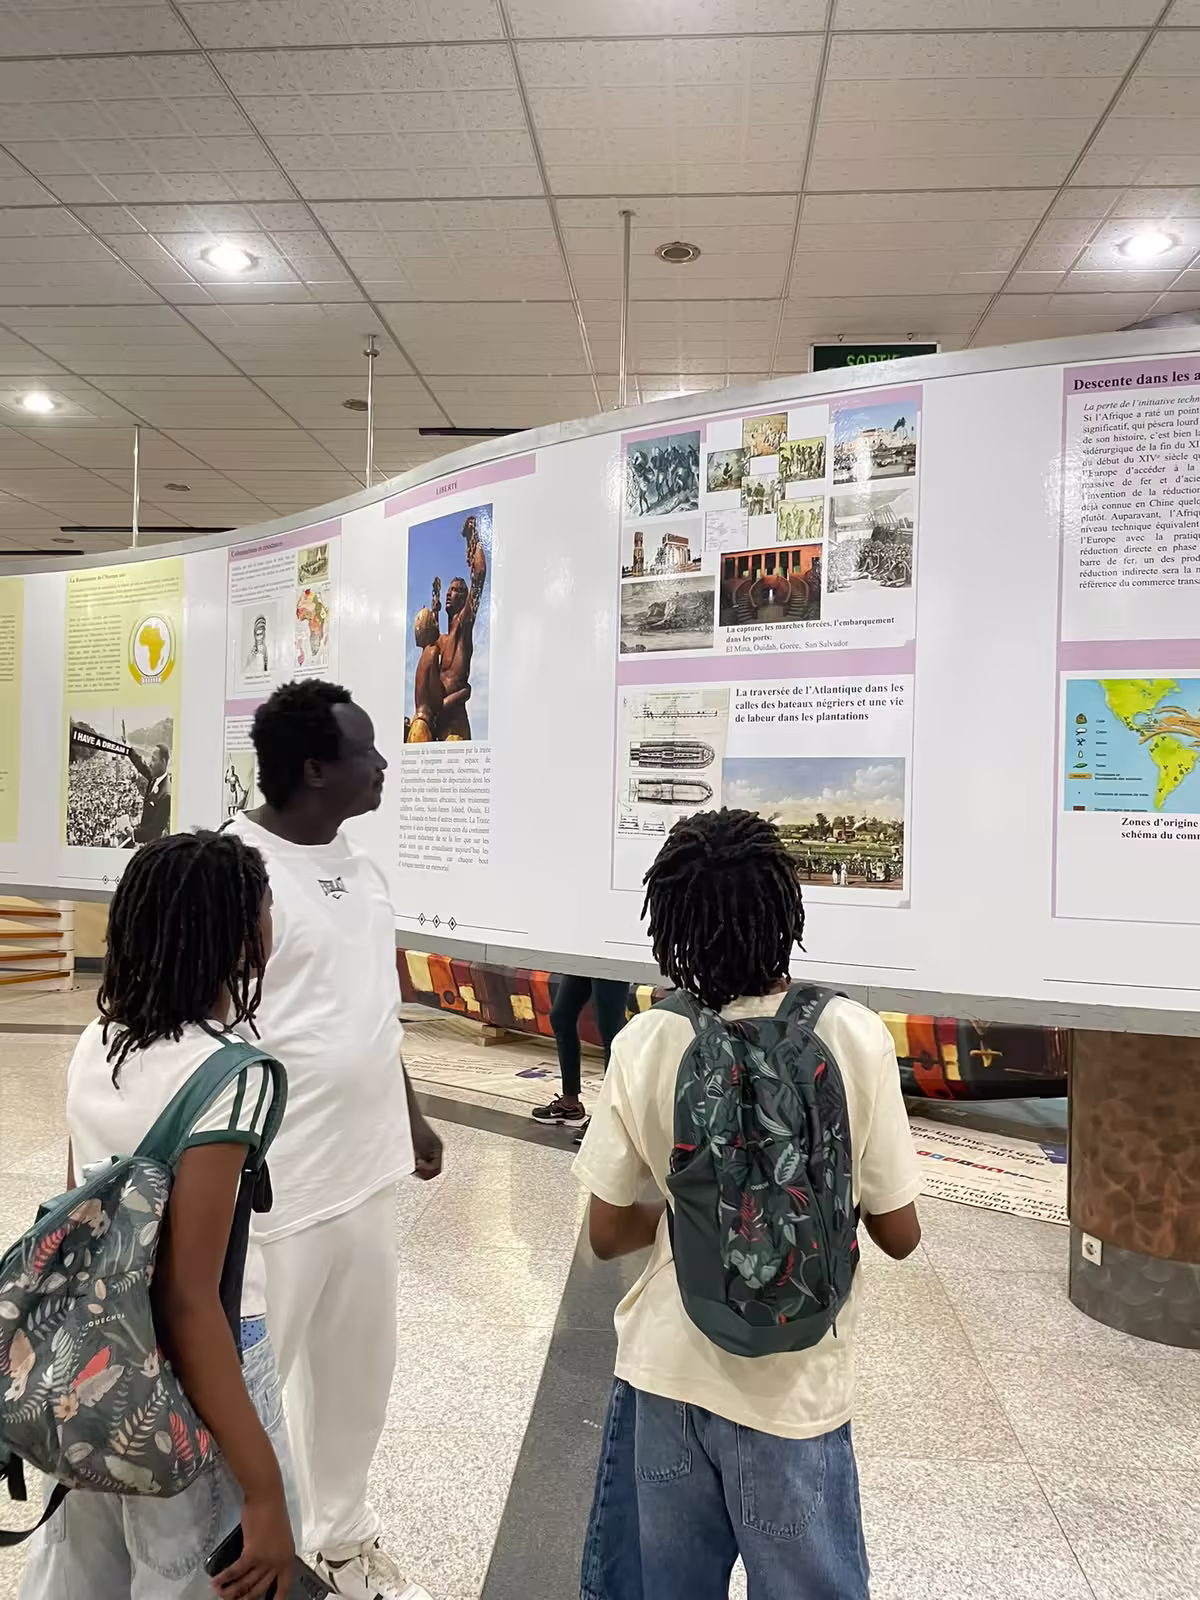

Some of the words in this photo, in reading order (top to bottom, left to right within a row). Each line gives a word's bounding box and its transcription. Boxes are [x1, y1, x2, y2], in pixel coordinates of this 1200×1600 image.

[1074, 376, 1132, 391] Descente
[1137, 374, 1168, 385] dans
[1173, 371, 1190, 382] les
[1096, 402, 1118, 412] perte
[1120, 400, 1130, 408] de
[1132, 398, 1175, 407] l'initiative
[1178, 395, 1200, 404] techn
[1084, 414, 1092, 422] Si
[1096, 412, 1133, 421] l'Afrique
[1145, 410, 1160, 418] raté
[1178, 407, 1199, 419] point
[1083, 423, 1129, 434] significatif,
[1132, 422, 1145, 431] qui
[1177, 418, 1199, 426] lourd
[1083, 436, 1092, 444] de
[1114, 434, 1147, 443] histoire,
[1150, 431, 1170, 439] c'est
[1173, 429, 1191, 438] bien
[1083, 446, 1133, 456] sidérurgique
[1160, 442, 1171, 450] fin
[1175, 441, 1185, 449] du
[1097, 457, 1119, 465] début
[1124, 456, 1134, 464] du
[1165, 452, 1188, 461] siècle
[1083, 468, 1118, 477] l'Europe
[1126, 466, 1166, 475] d'accéder
[1174, 464, 1179, 472] à
[1082, 491, 1126, 500] l'invention
[1133, 489, 1142, 497] de
[1150, 499, 1174, 507] Chine
[1111, 512, 1161, 521] Auparavant,
[1081, 524, 1108, 533] niveau
[1112, 523, 1151, 534] technique
[1156, 521, 1199, 530] équivalent
[1080, 536, 1116, 545] l'Europe
[1156, 533, 1163, 541] la
[1080, 546, 1118, 555] réduction
[1124, 545, 1152, 553] directe
[1173, 544, 1197, 553] phase
[1080, 559, 1101, 567] barre
[1182, 555, 1200, 564] prod
[1080, 569, 1117, 577] réduction
[1122, 567, 1158, 576] indirecte
[1184, 566, 1191, 574] la
[1080, 580, 1117, 589] référence
[737, 625, 764, 634] capture,
[834, 617, 895, 627] l'embarquement
[743, 634, 751, 642] les
[753, 635, 772, 644] ports:
[819, 640, 848, 648] Salvador
[736, 689, 747, 697] La
[750, 687, 790, 696] traversée
[806, 684, 862, 696] l'Atlantique
[865, 684, 888, 692] dans
[891, 683, 904, 691] les
[735, 701, 758, 710] calles
[761, 701, 775, 709] des
[778, 699, 813, 708] bateaux
[816, 698, 854, 709] négriers
[869, 698, 887, 706] une
[735, 714, 745, 722] de
[747, 713, 776, 722] labeur
[778, 713, 799, 722] dans
[802, 712, 813, 721] les
[816, 712, 869, 723] plantations
[73, 731, 77, 740] I
[78, 733, 95, 745] HAVE
[102, 740, 125, 753] DREAM
[1122, 818, 1151, 826] Zones
[1154, 819, 1199, 829] d'origine
[1121, 830, 1157, 839] schéma
[1014, 1196, 1067, 1210] l'intéri
